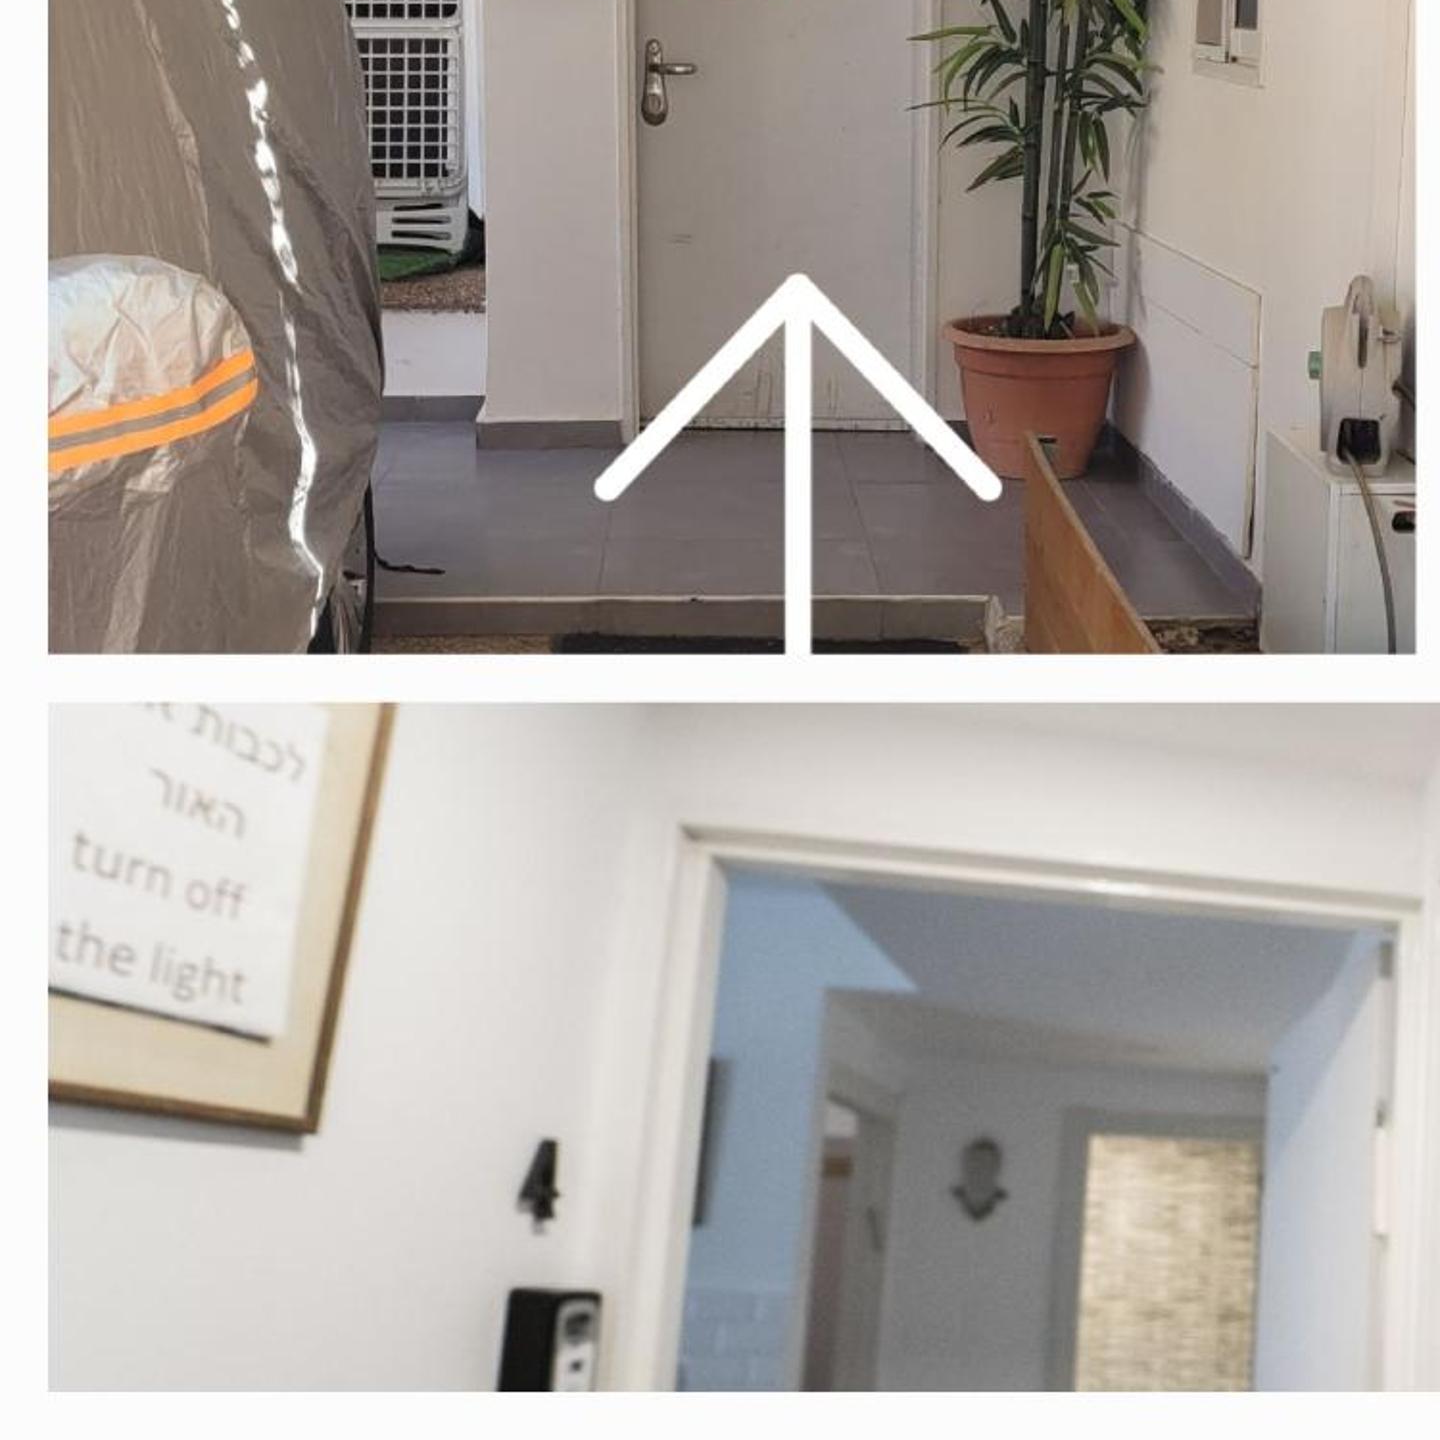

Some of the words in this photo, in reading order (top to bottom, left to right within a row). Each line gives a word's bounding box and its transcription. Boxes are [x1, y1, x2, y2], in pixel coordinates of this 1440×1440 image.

[190, 704, 307, 782] לכבות
[149, 767, 247, 839] האור
[72, 831, 172, 900] turn
[185, 877, 247, 920] off
[55, 921, 136, 977] the
[150, 942, 248, 1006] light
[517, 1138, 559, 1233] 4
